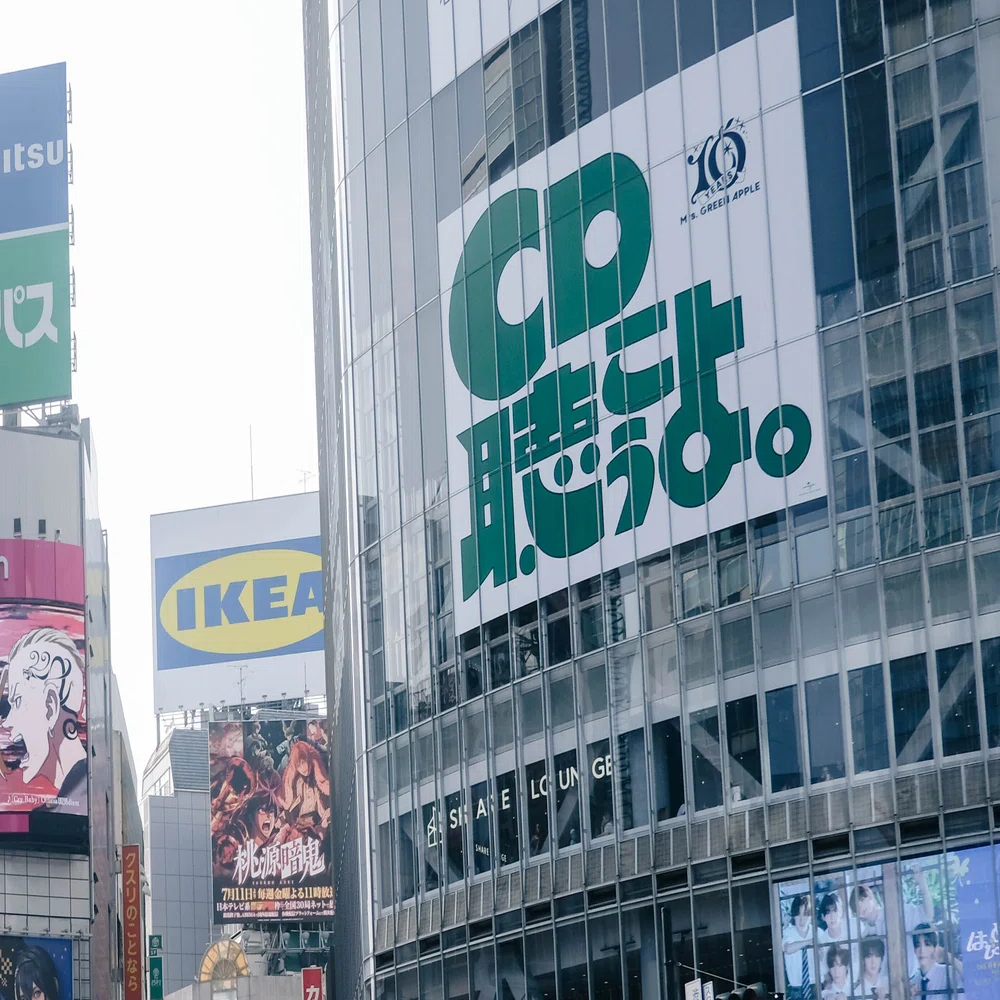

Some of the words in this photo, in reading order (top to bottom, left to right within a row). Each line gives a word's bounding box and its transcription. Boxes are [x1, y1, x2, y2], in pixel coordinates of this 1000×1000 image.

[680, 212, 699, 225] Ms.
[700, 197, 730, 216] GREEN
[732, 181, 761, 202] APPLE
[449, 152, 652, 401] CD
[176, 570, 324, 631] IKEA
[233, 837, 325, 886] 桃源暗鬼
[222, 887, 253, 901] 7月11日
[126, 853, 139, 992] クスリのことなら
